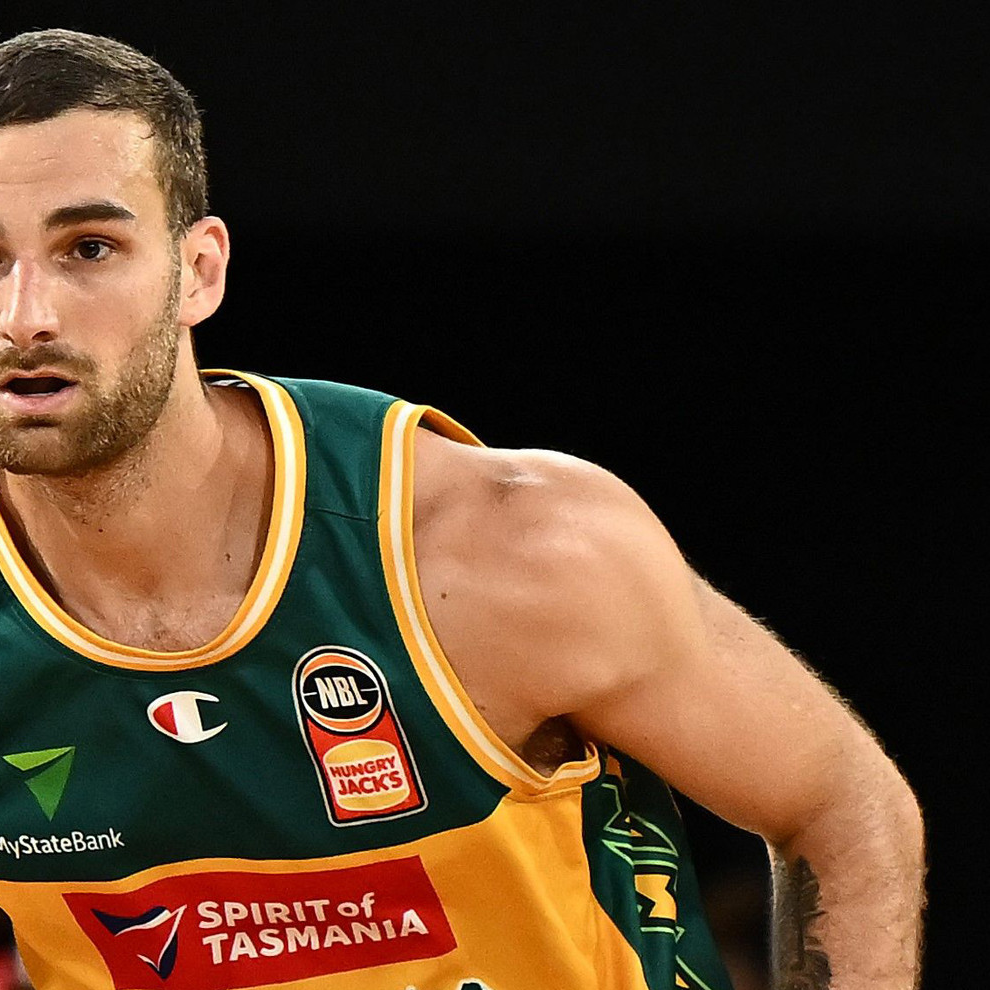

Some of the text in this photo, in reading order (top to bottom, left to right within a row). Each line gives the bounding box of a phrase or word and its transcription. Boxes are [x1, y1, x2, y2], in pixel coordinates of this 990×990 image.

[314, 676, 368, 709] NBL
[329, 756, 396, 778] HUNGRY
[338, 770, 404, 795] JACK'S
[197, 892, 376, 929] SPIRIT of
[202, 908, 429, 964] TASMANIA
